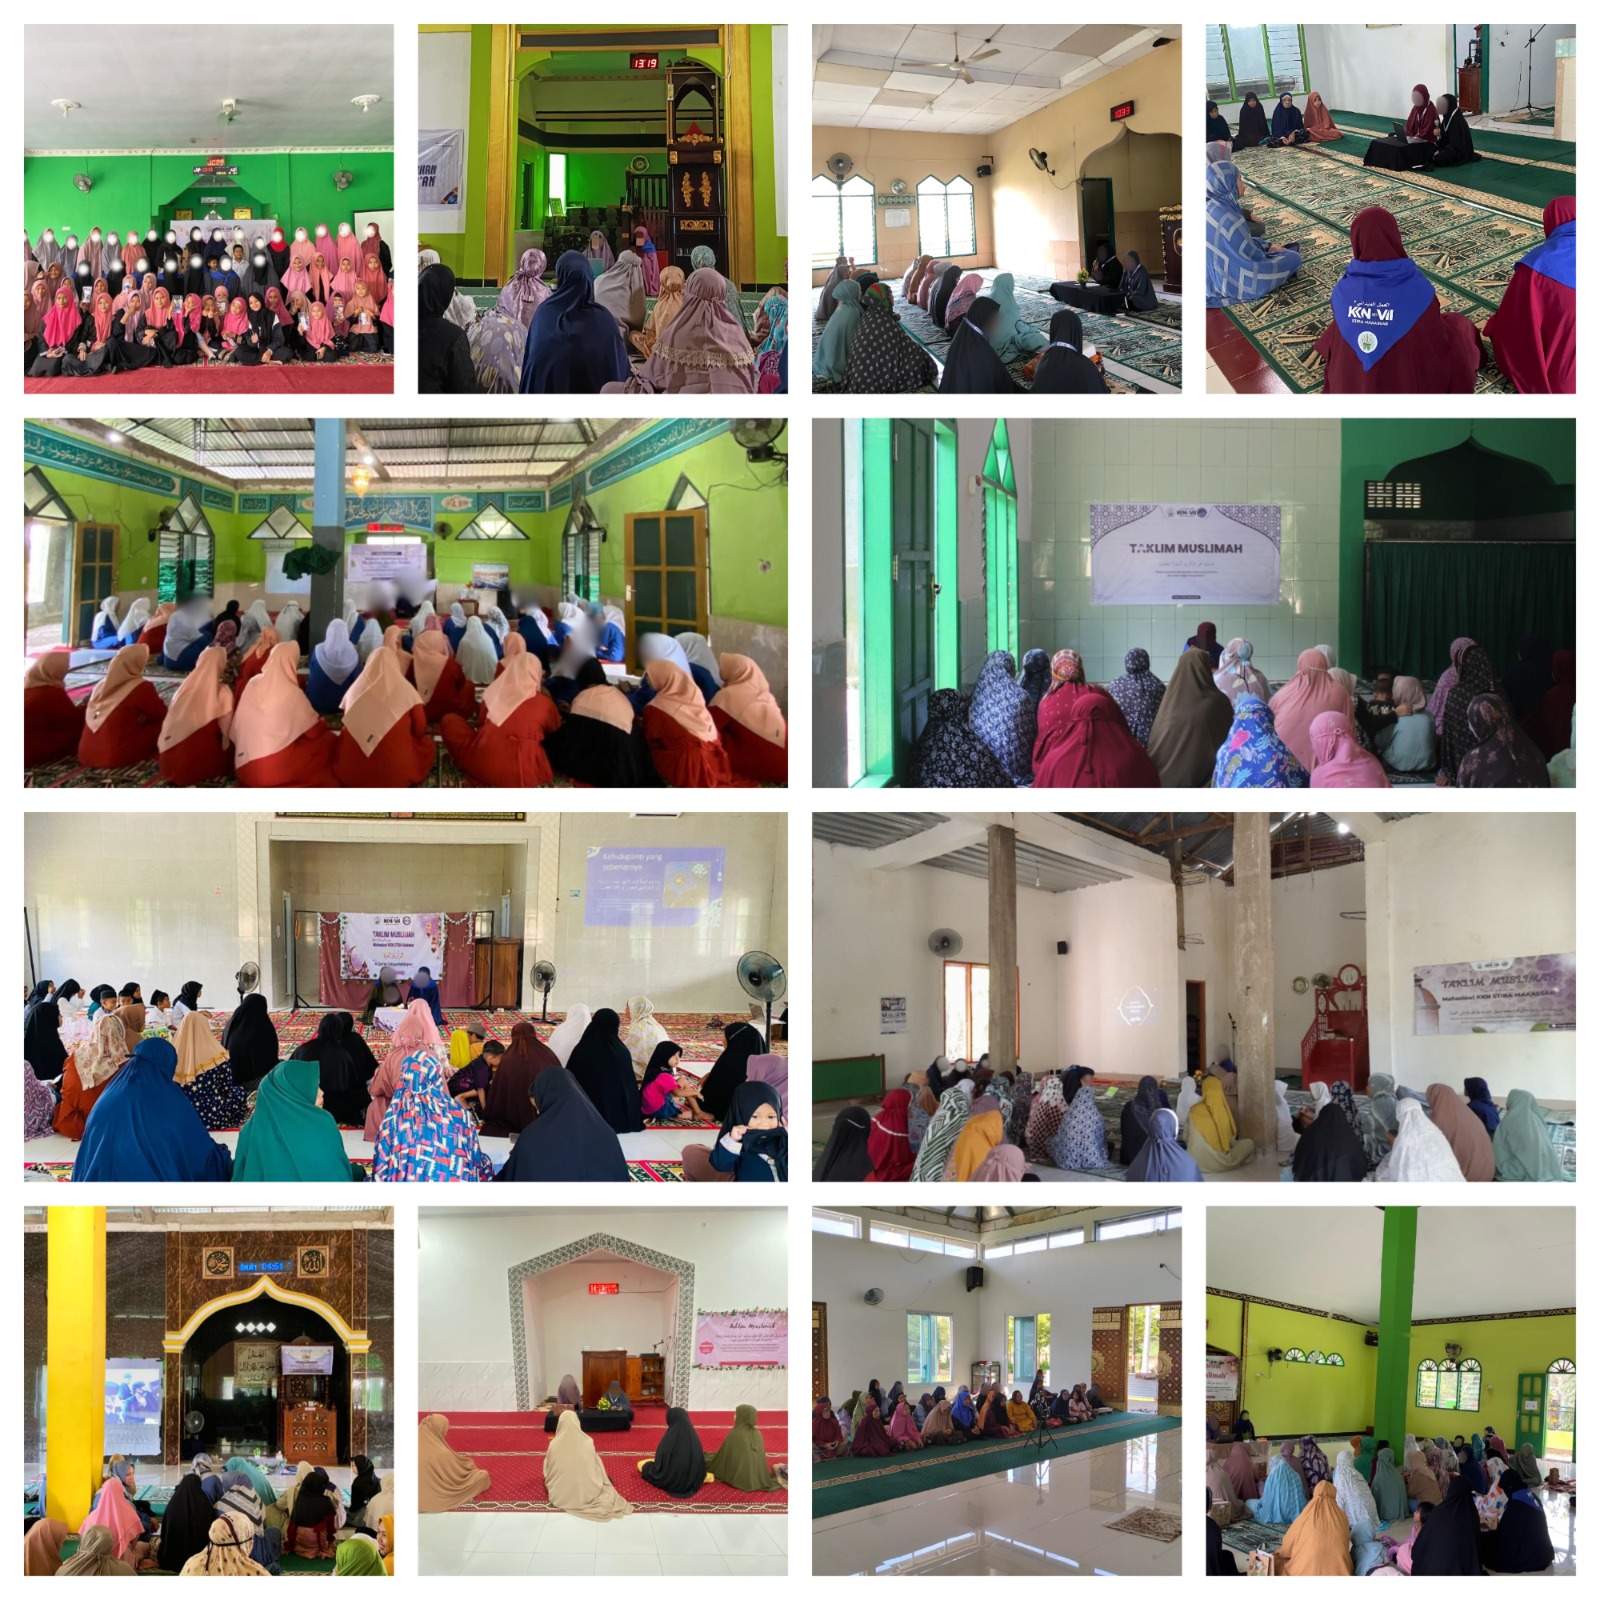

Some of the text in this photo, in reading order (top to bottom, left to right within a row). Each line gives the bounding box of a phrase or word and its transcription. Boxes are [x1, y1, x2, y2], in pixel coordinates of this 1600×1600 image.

[1129, 543, 1243, 554] TAKLIM MUSLIMAH
[1441, 978, 1485, 989] TAKLIM
